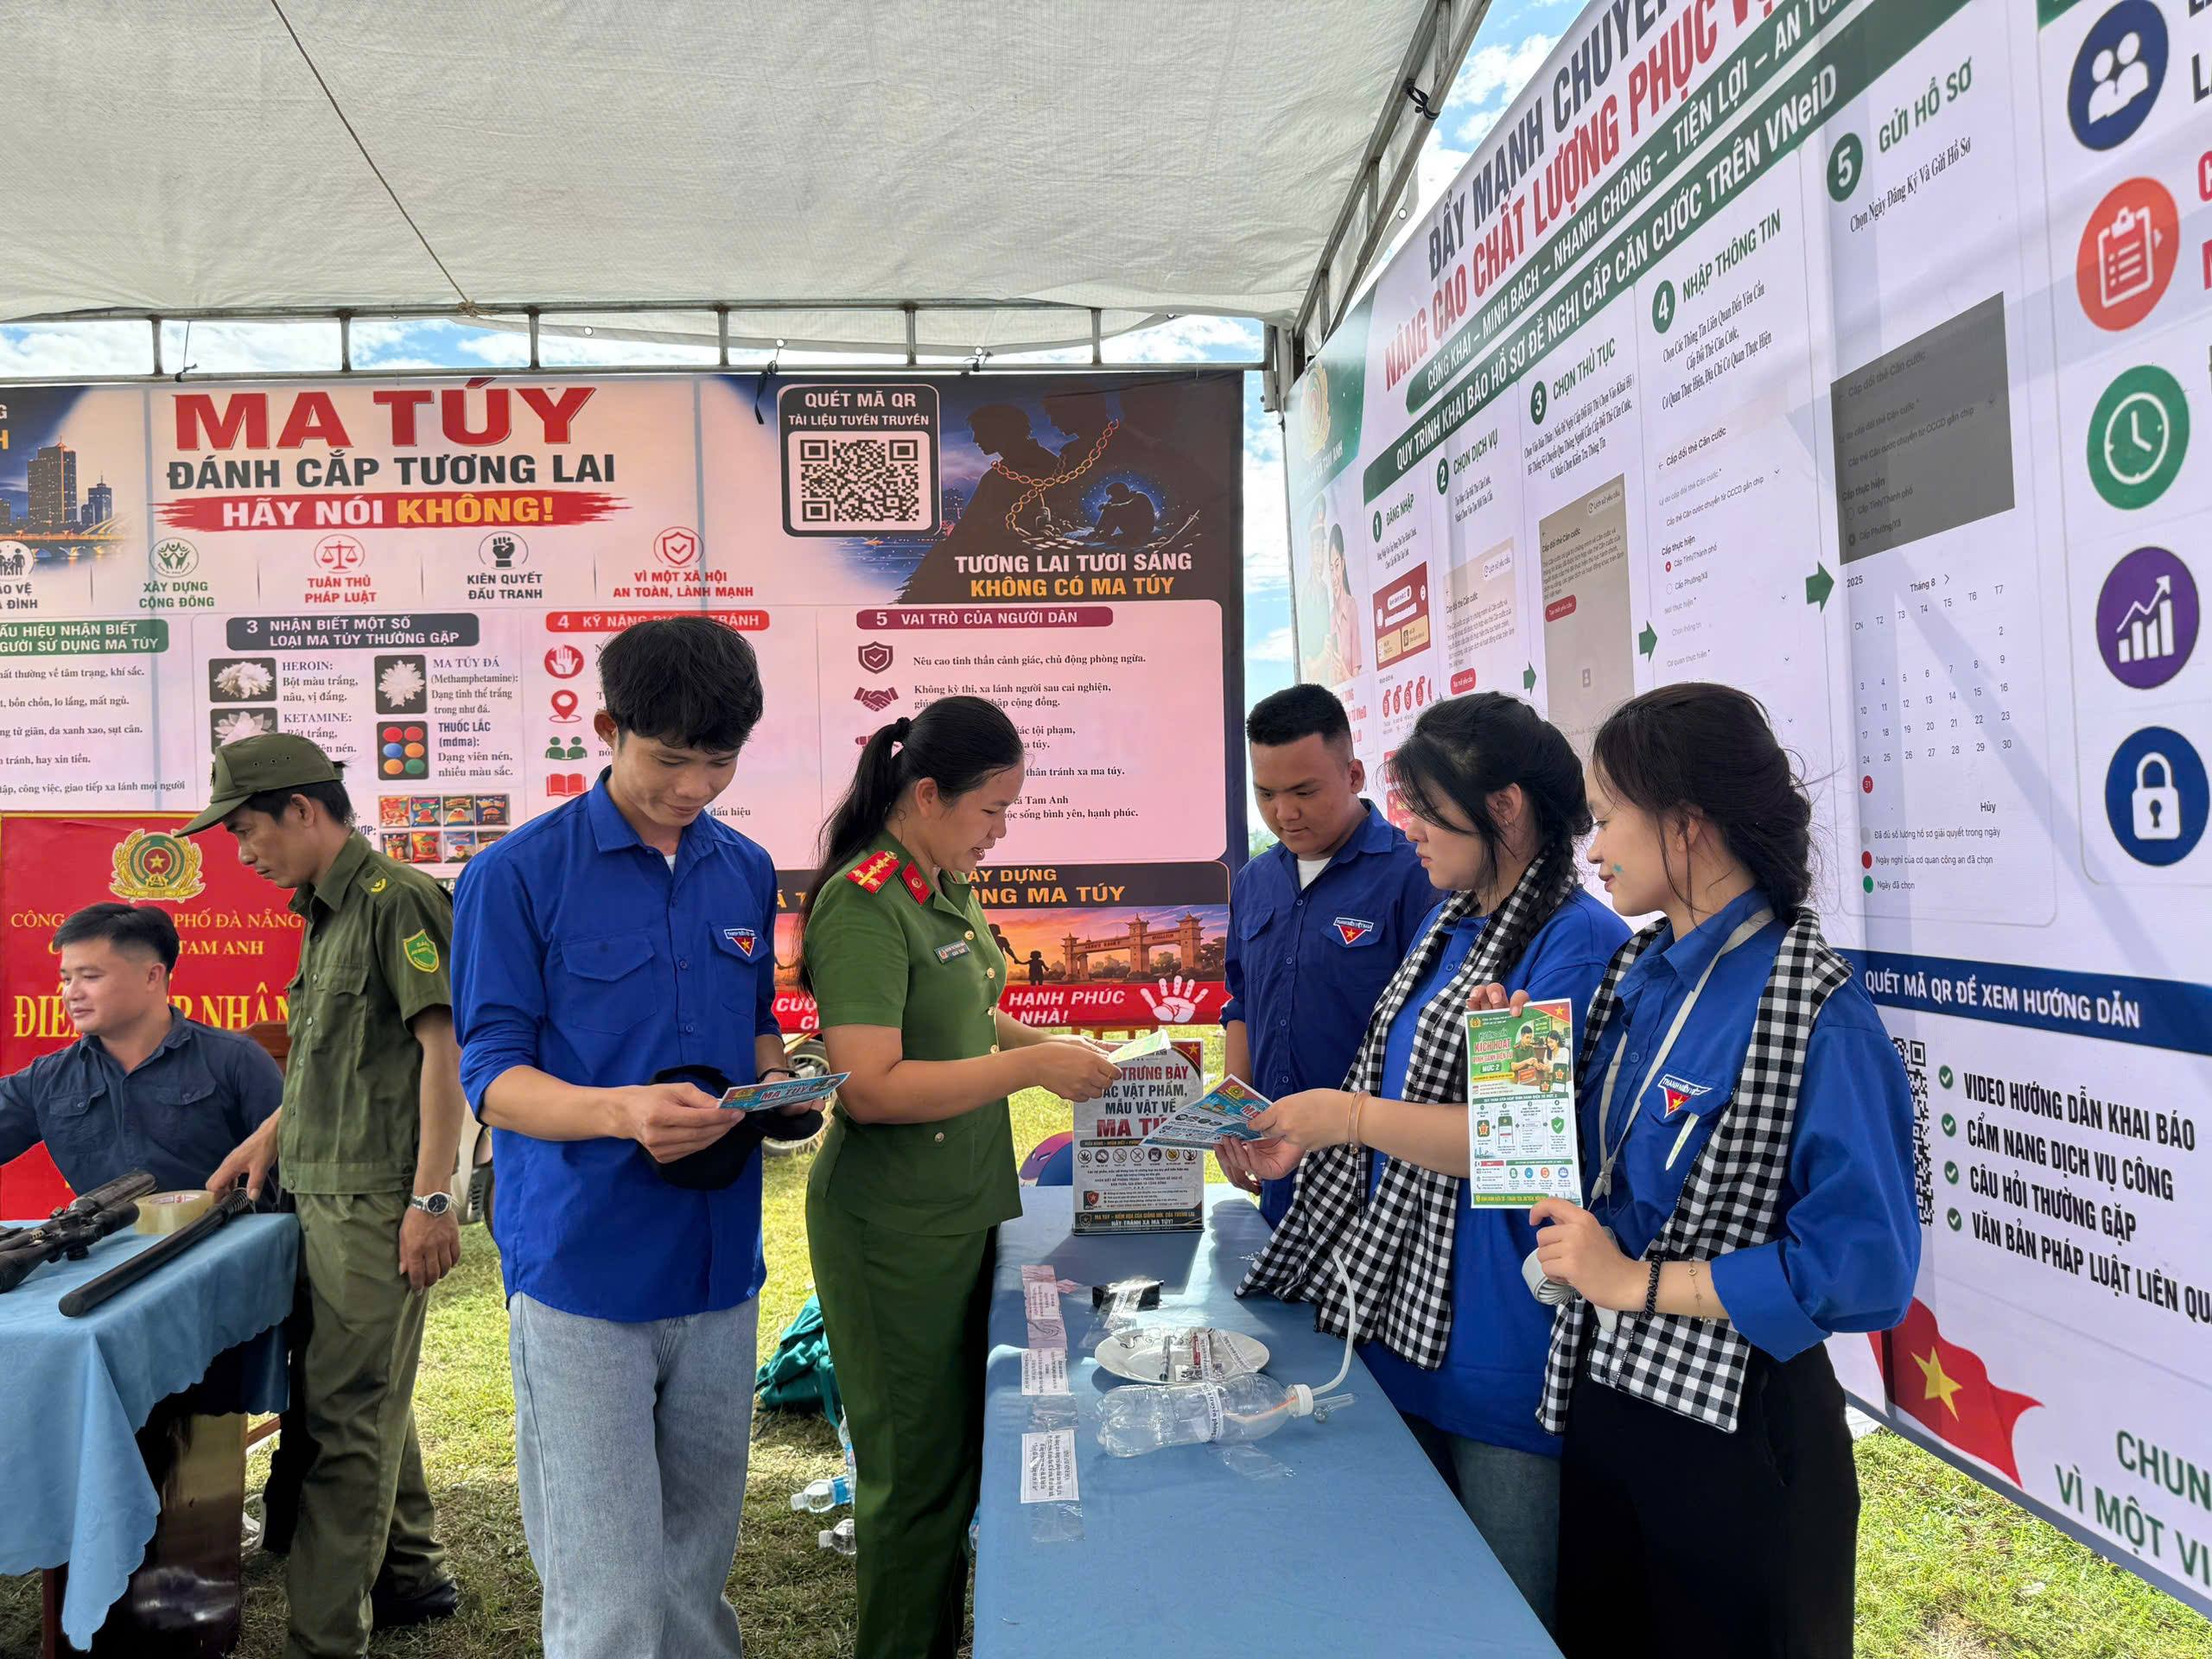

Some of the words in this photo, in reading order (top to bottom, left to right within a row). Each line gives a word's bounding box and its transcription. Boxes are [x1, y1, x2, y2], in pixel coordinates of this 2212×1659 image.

[1879, 107, 1909, 153] GỬI
[1914, 76, 1940, 128] HỒ
[1947, 56, 1972, 102] SƠ
[1838, 145, 1853, 188] 5
[1383, 308, 1427, 391] NÂNG
[1432, 264, 1467, 340] CAO
[1472, 190, 1525, 297] CHẤT
[1533, 93, 1621, 238] LƯỢNG
[1628, 0, 1718, 137] PHỤC
[1429, 189, 1465, 281] ĐẨY
[1472, 96, 1544, 231] MẠNH
[1850, 211, 1868, 232] Chọn
[1868, 197, 1885, 220] Ngày
[1887, 185, 1906, 207] Đăng
[1907, 172, 1917, 194] Ký
[1919, 164, 1930, 184] Và
[1960, 137, 1971, 157] Sơ
[1427, 355, 1450, 391] CÔNG
[1451, 332, 1471, 370] KHAI
[1482, 296, 1508, 339] MINH
[1510, 264, 1540, 313] BẠCH
[1554, 207, 1598, 270] NHANH
[1601, 155, 1651, 225] CHÓNG
[1673, 92, 1713, 155] TIỆN
[1718, 57, 1748, 114] LỢI
[1774, 3, 1802, 60] AN
[1682, 263, 1713, 302] NHẬP
[1715, 228, 1757, 277] THÔNG
[1758, 208, 1781, 244] TIN
[1396, 439, 1414, 471] QUY
[1414, 416, 1440, 455] TRÌNH
[1441, 391, 1465, 432] KHAI
[1467, 372, 1488, 411] BÁO
[1491, 347, 1507, 391] HỒ
[1510, 339, 1525, 374] SƠ
[1547, 290, 1580, 342] NGHỊ
[1583, 260, 1611, 312] CẤP
[1616, 230, 1648, 283] CĂN
[1652, 183, 1701, 251] CƯỚC
[1707, 129, 1760, 204] TRÊN
[1658, 291, 1669, 321] 4
[1554, 367, 1575, 400] CHỌN
[1577, 348, 1595, 382] THỦ
[1598, 338, 1616, 366] TỤC
[804, 391, 851, 408] QUÉT
[857, 390, 886, 408] MÃ
[892, 393, 917, 408] QR
[1535, 390, 1542, 416] 3
[173, 391, 353, 451] MA
[373, 377, 597, 448] TÚY
[788, 413, 807, 426] TÀI
[811, 413, 837, 428] LIỆU
[167, 454, 281, 491] ĐÁNH
[296, 449, 379, 487] CẮP
[394, 454, 536, 486] TƯƠNG
[552, 454, 614, 483] LAI
[223, 498, 301, 527] HÃY
[315, 495, 383, 524] NÓI
[397, 493, 553, 524] KHÔNG!
[955, 554, 1030, 574] TƯƠNG
[1035, 556, 1070, 572] LAI
[1076, 554, 1127, 572] TƯƠI
[1134, 551, 1193, 571] SÁNG
[635, 569, 647, 583] VÌ
[652, 569, 680, 584] MỘT
[704, 568, 728, 584] HỘI
[969, 574, 1048, 598] KHÔNG
[1053, 575, 1085, 596] CÓ
[1091, 577, 1127, 596] MA
[1132, 573, 1174, 595] TÚY
[1847, 575, 1863, 588] 2025
[1910, 580, 1929, 594] Tháng
[1930, 578, 1936, 588] 8
[613, 587, 630, 598] AN
[677, 584, 712, 598] LÀNH
[715, 585, 753, 600] MẠNH
[246, 620, 258, 633] 3
[270, 620, 311, 632] NHẬN
[317, 616, 346, 630] BIẾT
[354, 618, 386, 631] MỘT
[391, 615, 411, 629] SỐ
[876, 613, 888, 626] 5
[901, 613, 924, 625] VAI
[930, 611, 958, 625] TRÒ
[963, 611, 992, 624] CỦA
[998, 610, 1043, 623] NGƯỜI
[1048, 610, 1077, 623] DÂN
[270, 635, 302, 647] LOẠI
[310, 635, 329, 645] MA
[334, 632, 361, 645] TÚY
[366, 632, 425, 644] THƯỜNG
[429, 632, 460, 645] GẶP
[283, 661, 333, 671] HEROIN:
[434, 658, 452, 668] MA
[455, 657, 480, 668] TÚY
[483, 657, 499, 668] ĐÁ
[913, 656, 931, 666] Nêu
[952, 655, 970, 666] tinh
[974, 653, 995, 665] thần
[1065, 654, 1087, 668] động
[283, 677, 301, 687] Bột
[302, 677, 325, 686] màu
[431, 673, 518, 684] (Methamphetamine):
[174, 908, 212, 927] PHỐ
[216, 910, 242, 927] ĐÀ
[180, 941, 218, 955] TAM
[221, 941, 264, 955] ANH
[1008, 991, 1064, 1008] HẠNH
[1071, 985, 1124, 1006] PHÚC
[1866, 967, 1900, 995] QUÉT
[1904, 972, 1928, 1000] MÃ
[1931, 978, 1953, 1001] QR
[1956, 974, 1978, 1005] ĐỂ
[1981, 983, 2018, 1012] XEM
[2023, 987, 2091, 1020] HƯỚNG
[1020, 1007, 1069, 1025] NHÀ!
[1123, 1065, 1162, 1080] TRƯNG
[1166, 1064, 1188, 1079] BÀY
[1123, 1084, 1143, 1100] VẬT
[1136, 1101, 1157, 1115] VẬT
[1963, 1072, 2005, 1107] VIDEO
[2010, 1081, 2063, 1121] HƯỚNG
[2107, 1103, 2151, 1141] KHAI
[2155, 1109, 2196, 1151] BÁO
[1096, 1119, 1132, 1137] MA
[1967, 1111, 2000, 1153] CẨM
[2004, 1128, 2046, 1166] NANG
[2051, 1140, 2090, 1178] DỊCH
[2094, 1151, 2117, 1192] VỤ
[2122, 1156, 2174, 1202] CÔNG
[1970, 1164, 1999, 1199] CÂU
[2003, 1170, 2028, 1209] HỎI
[2031, 1184, 2096, 1231] THƯỜNG
[2101, 1203, 2136, 1246] GẶP
[1972, 1210, 2002, 1248] VĂN
[2005, 1217, 2037, 1260] BẢN
[2041, 1237, 2084, 1276] PHÁP
[2089, 1252, 2130, 1296] LUẬT
[2136, 1268, 2178, 1313] LIÊN
[2055, 1463, 2084, 1514] VÌ
[2094, 1486, 2164, 1557] MỘT
